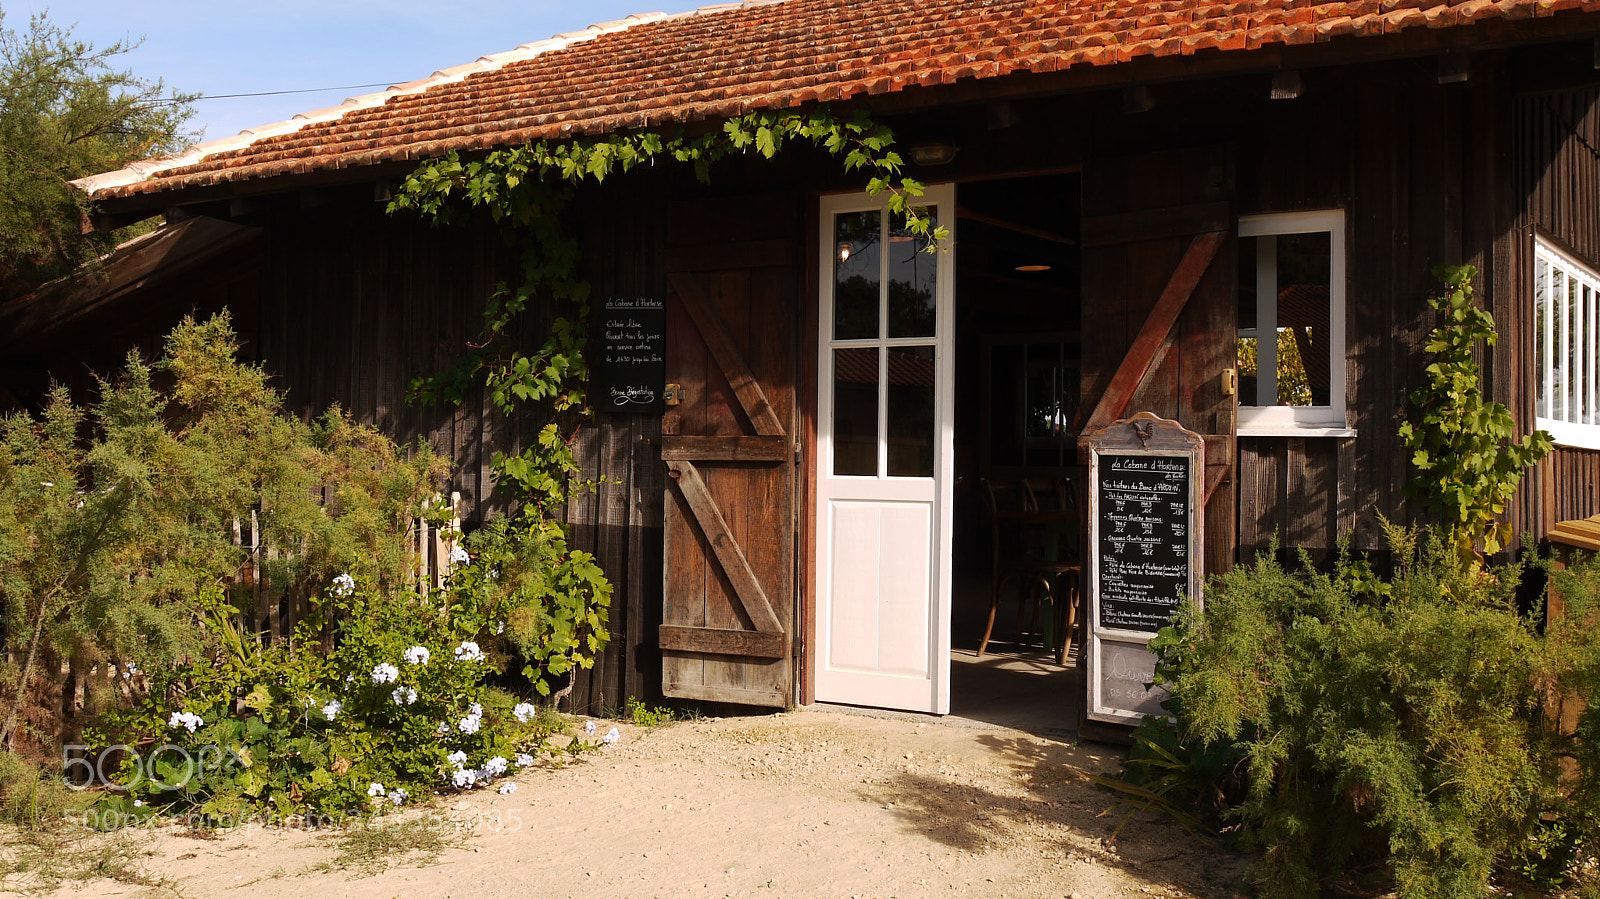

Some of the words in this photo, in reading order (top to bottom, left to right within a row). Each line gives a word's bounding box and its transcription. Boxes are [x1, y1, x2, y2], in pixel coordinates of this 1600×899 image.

[1112, 457, 1121, 468] La
[1123, 459, 1148, 469] Cabane
[1126, 690, 1137, 699] 56
